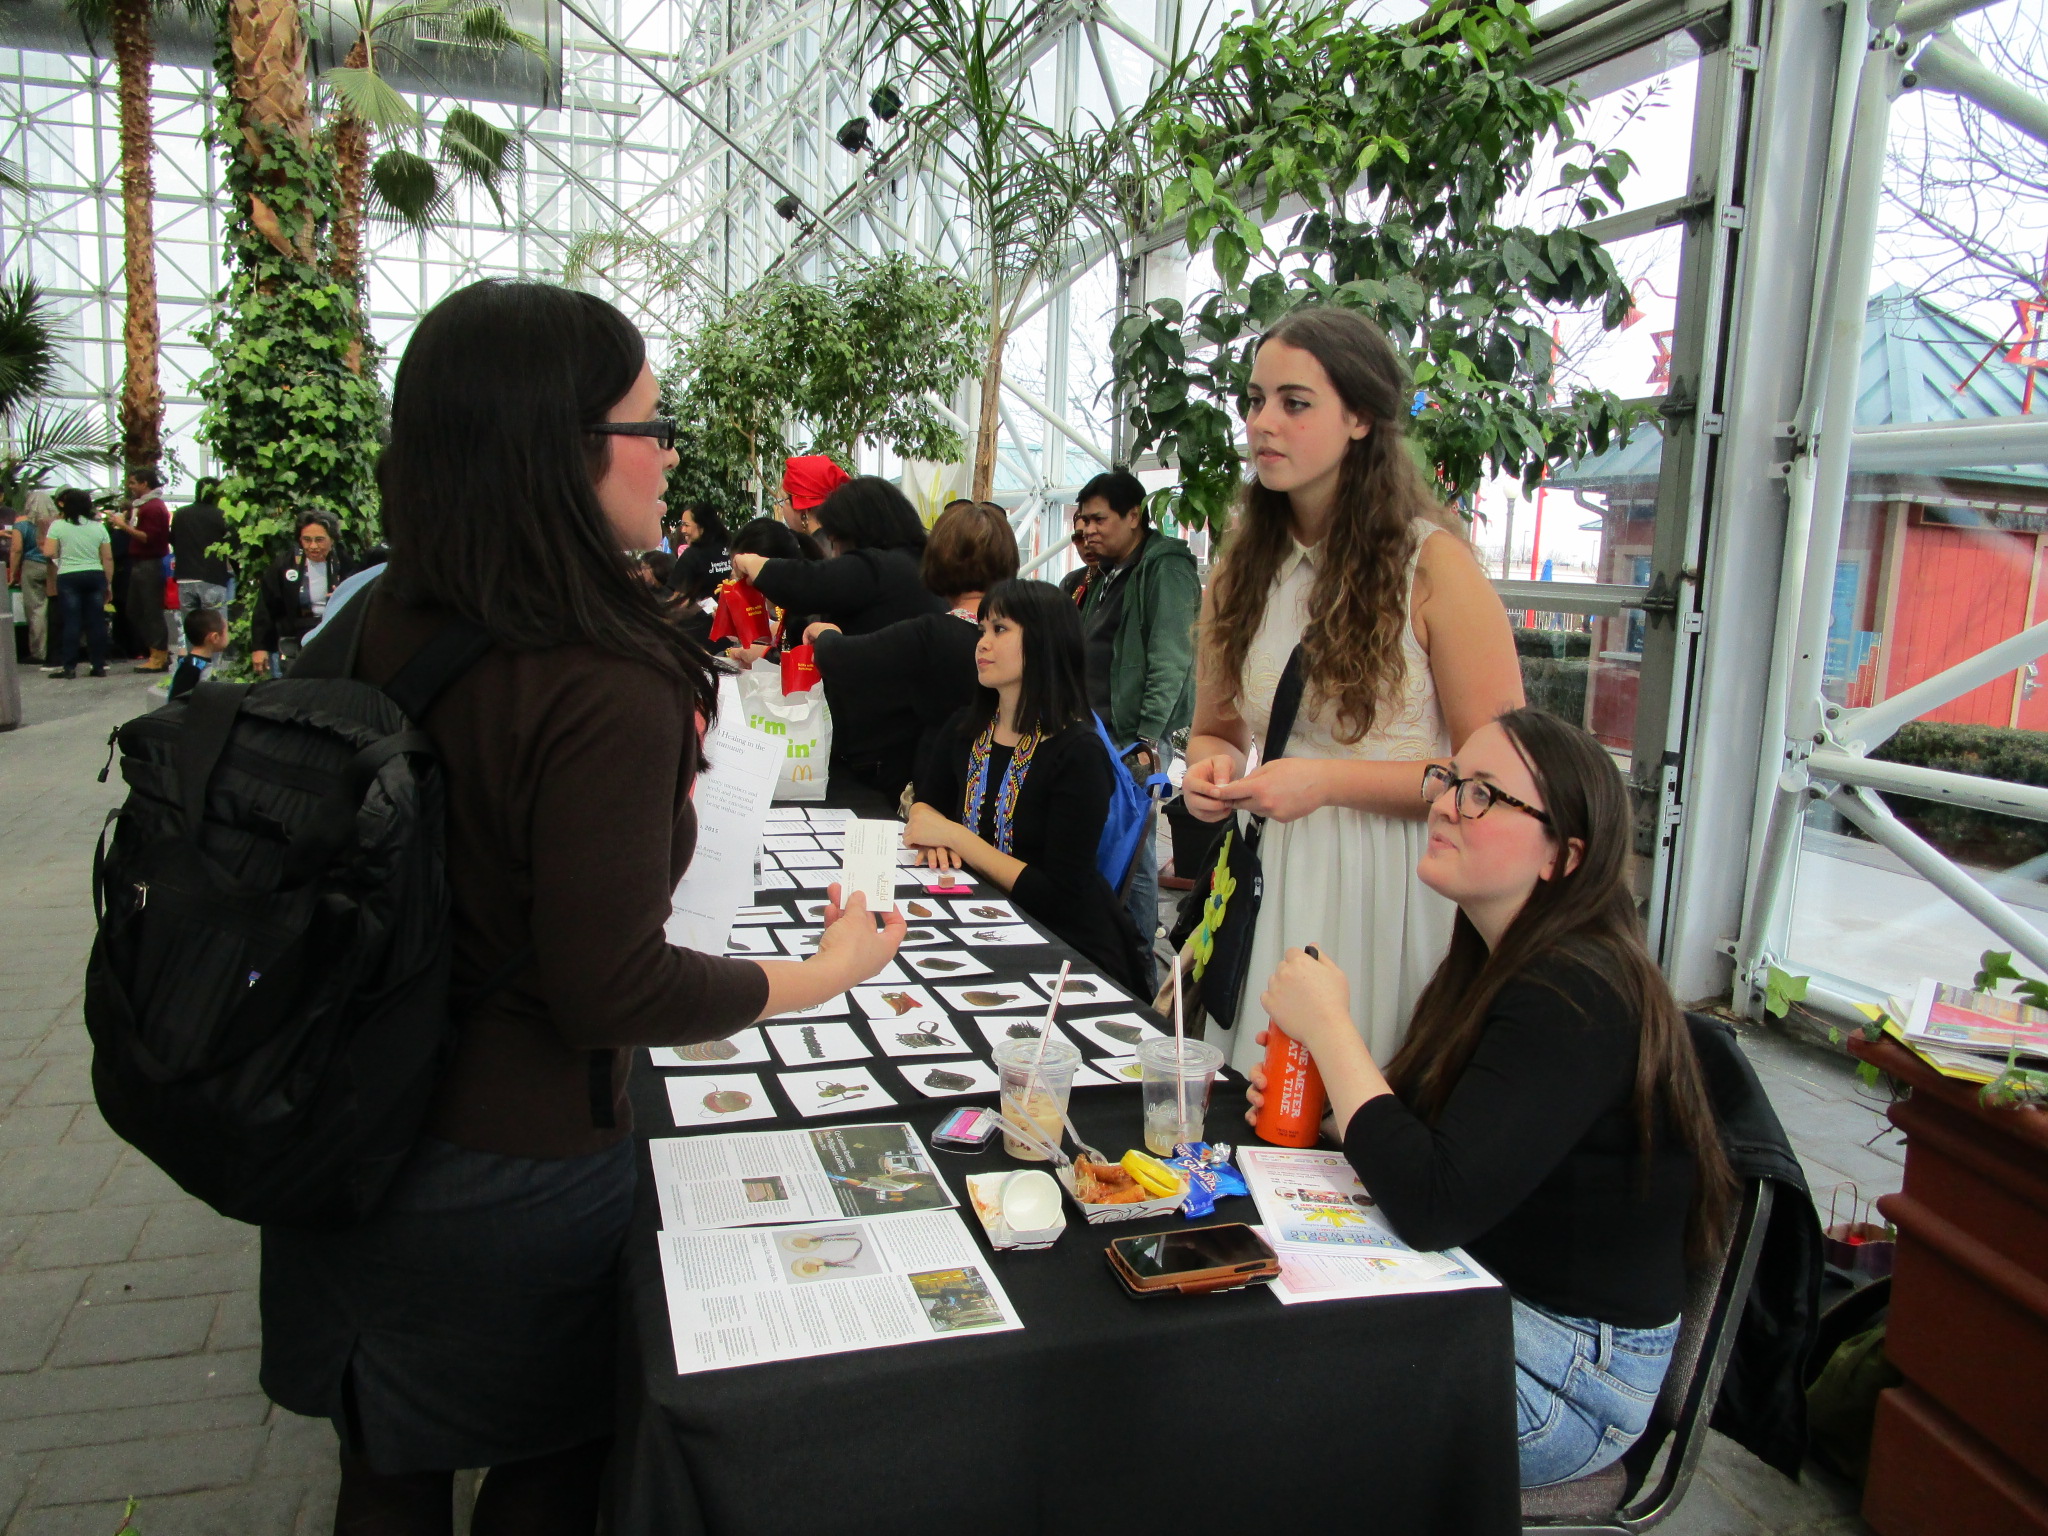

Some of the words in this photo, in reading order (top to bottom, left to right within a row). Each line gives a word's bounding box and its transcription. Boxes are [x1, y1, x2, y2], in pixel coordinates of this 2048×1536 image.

[750, 714, 786, 735] i'm
[721, 730, 746, 746] Healing
[755, 742, 766, 752] the
[786, 738, 817, 758] in'
[704, 825, 718, 834] 2015
[880, 880, 888, 901] Field
[1288, 1040, 1298, 1060] AT
[1298, 1046, 1309, 1066] NE
[1285, 1062, 1296, 1074] A
[1280, 1078, 1294, 1116] TIME.
[1291, 1070, 1306, 1118] METER
[1290, 1230, 1342, 1240] WORLD
